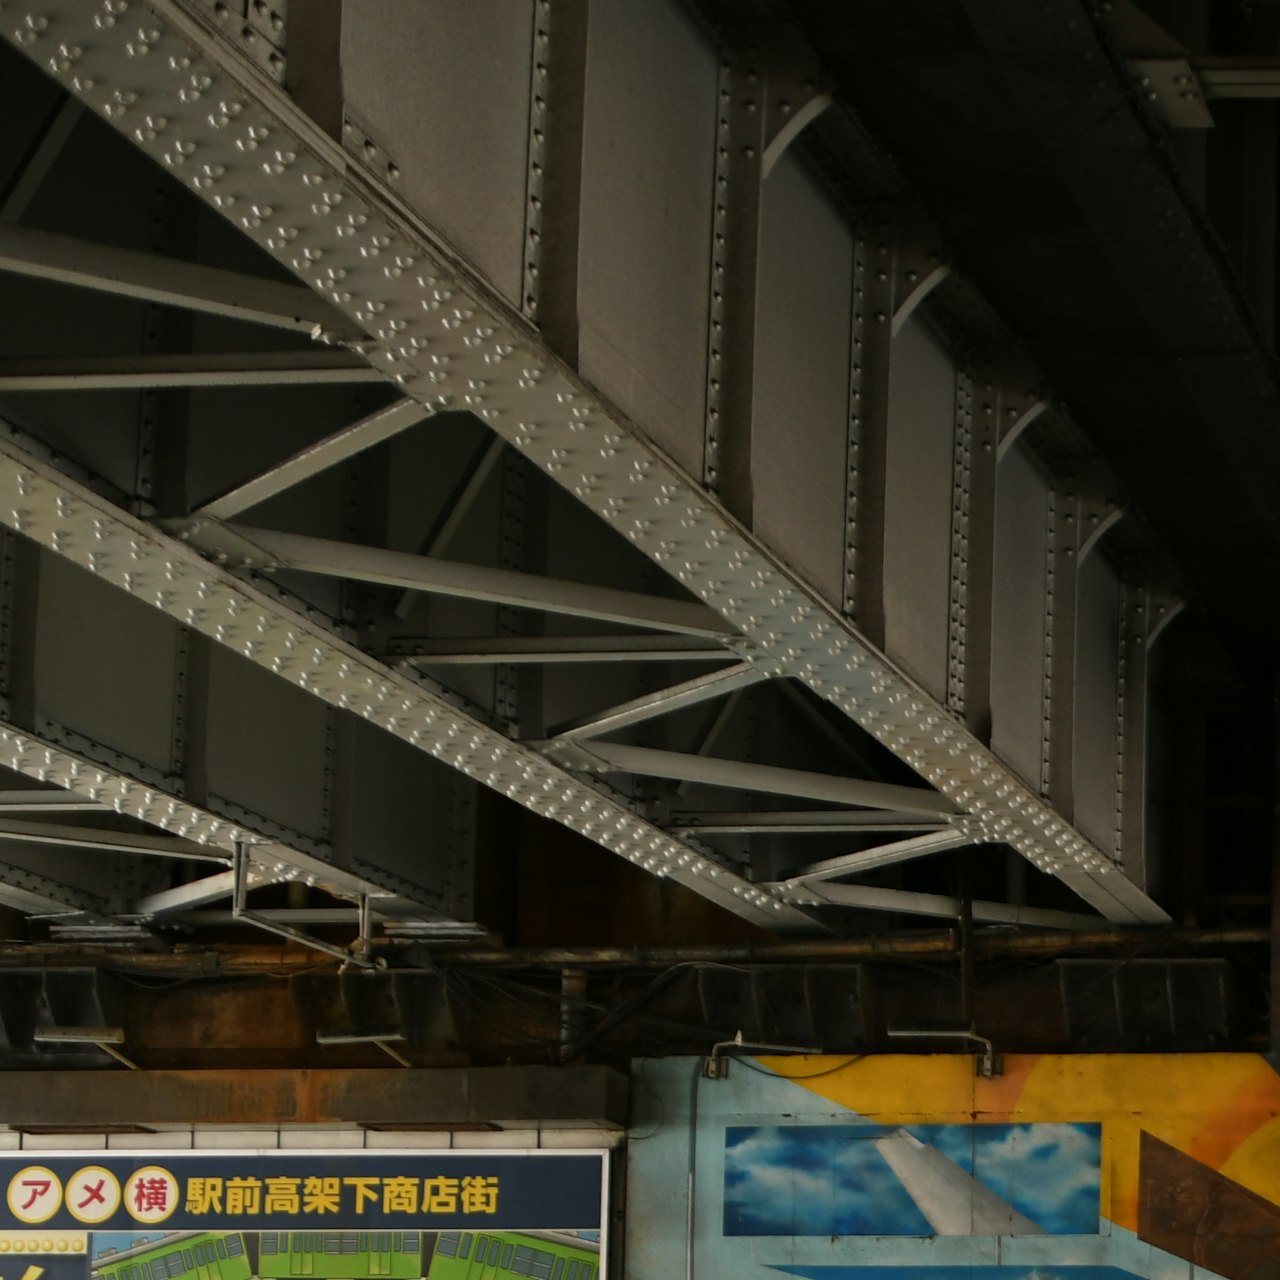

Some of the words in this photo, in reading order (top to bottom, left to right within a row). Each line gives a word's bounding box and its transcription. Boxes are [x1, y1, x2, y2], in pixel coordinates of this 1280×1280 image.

[16, 1174, 171, 1215] アメ横
[184, 1175, 500, 1215] 駅前高架下商店街
